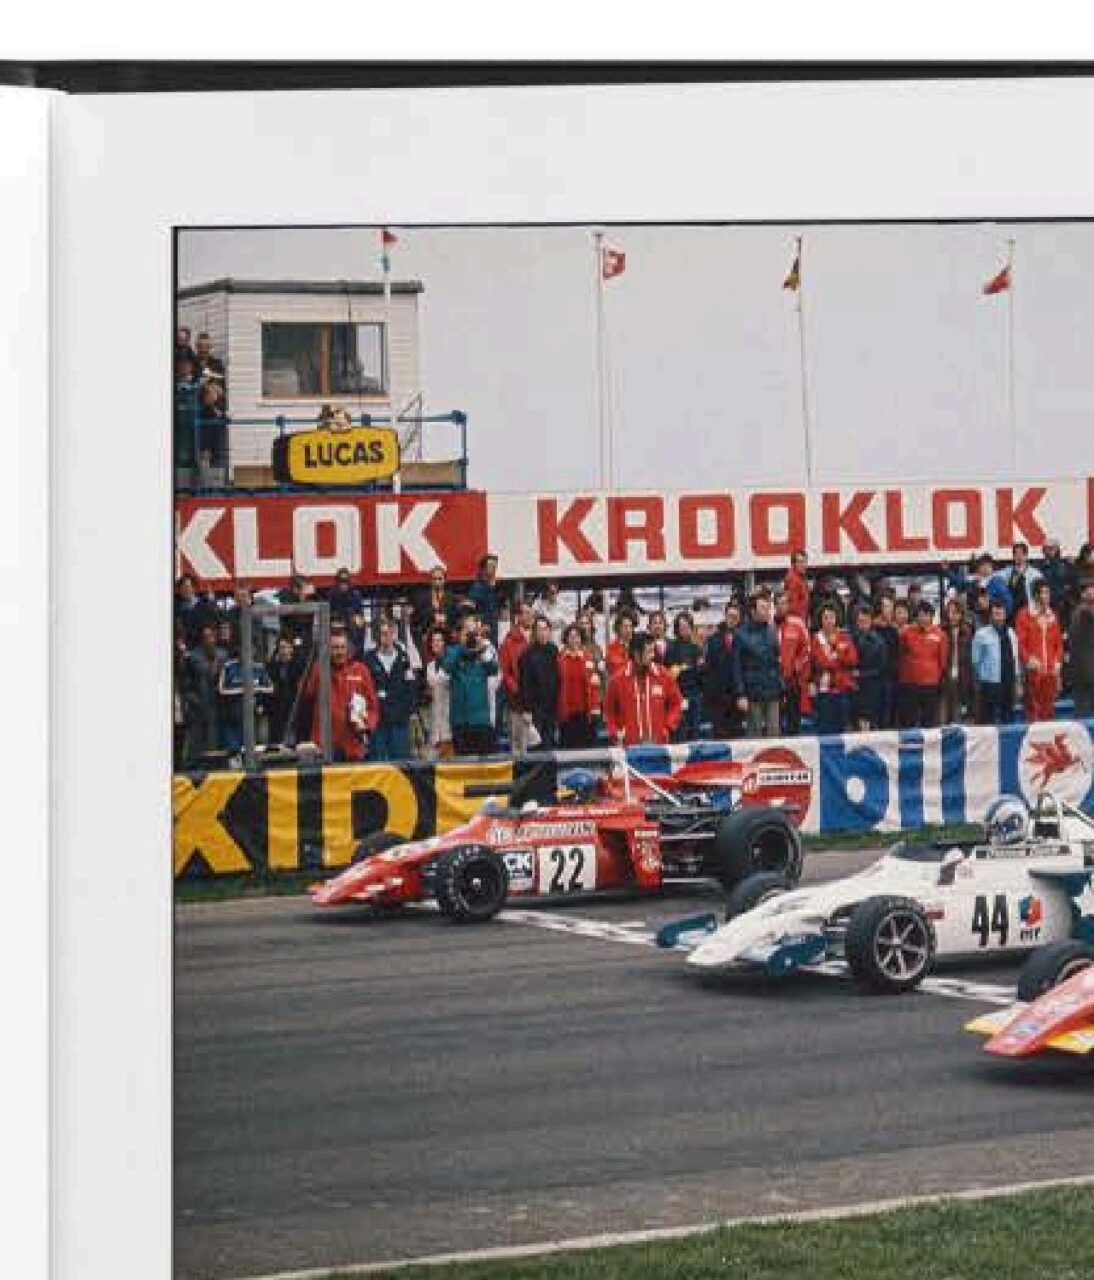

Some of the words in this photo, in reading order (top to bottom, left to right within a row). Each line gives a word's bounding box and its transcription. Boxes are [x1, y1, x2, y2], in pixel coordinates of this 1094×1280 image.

[304, 441, 385, 468] LUCAS
[174, 501, 447, 580] KLOK
[537, 487, 1047, 565] KROOKLOK
[550, 847, 584, 893] 22
[972, 894, 1009, 946] 44
